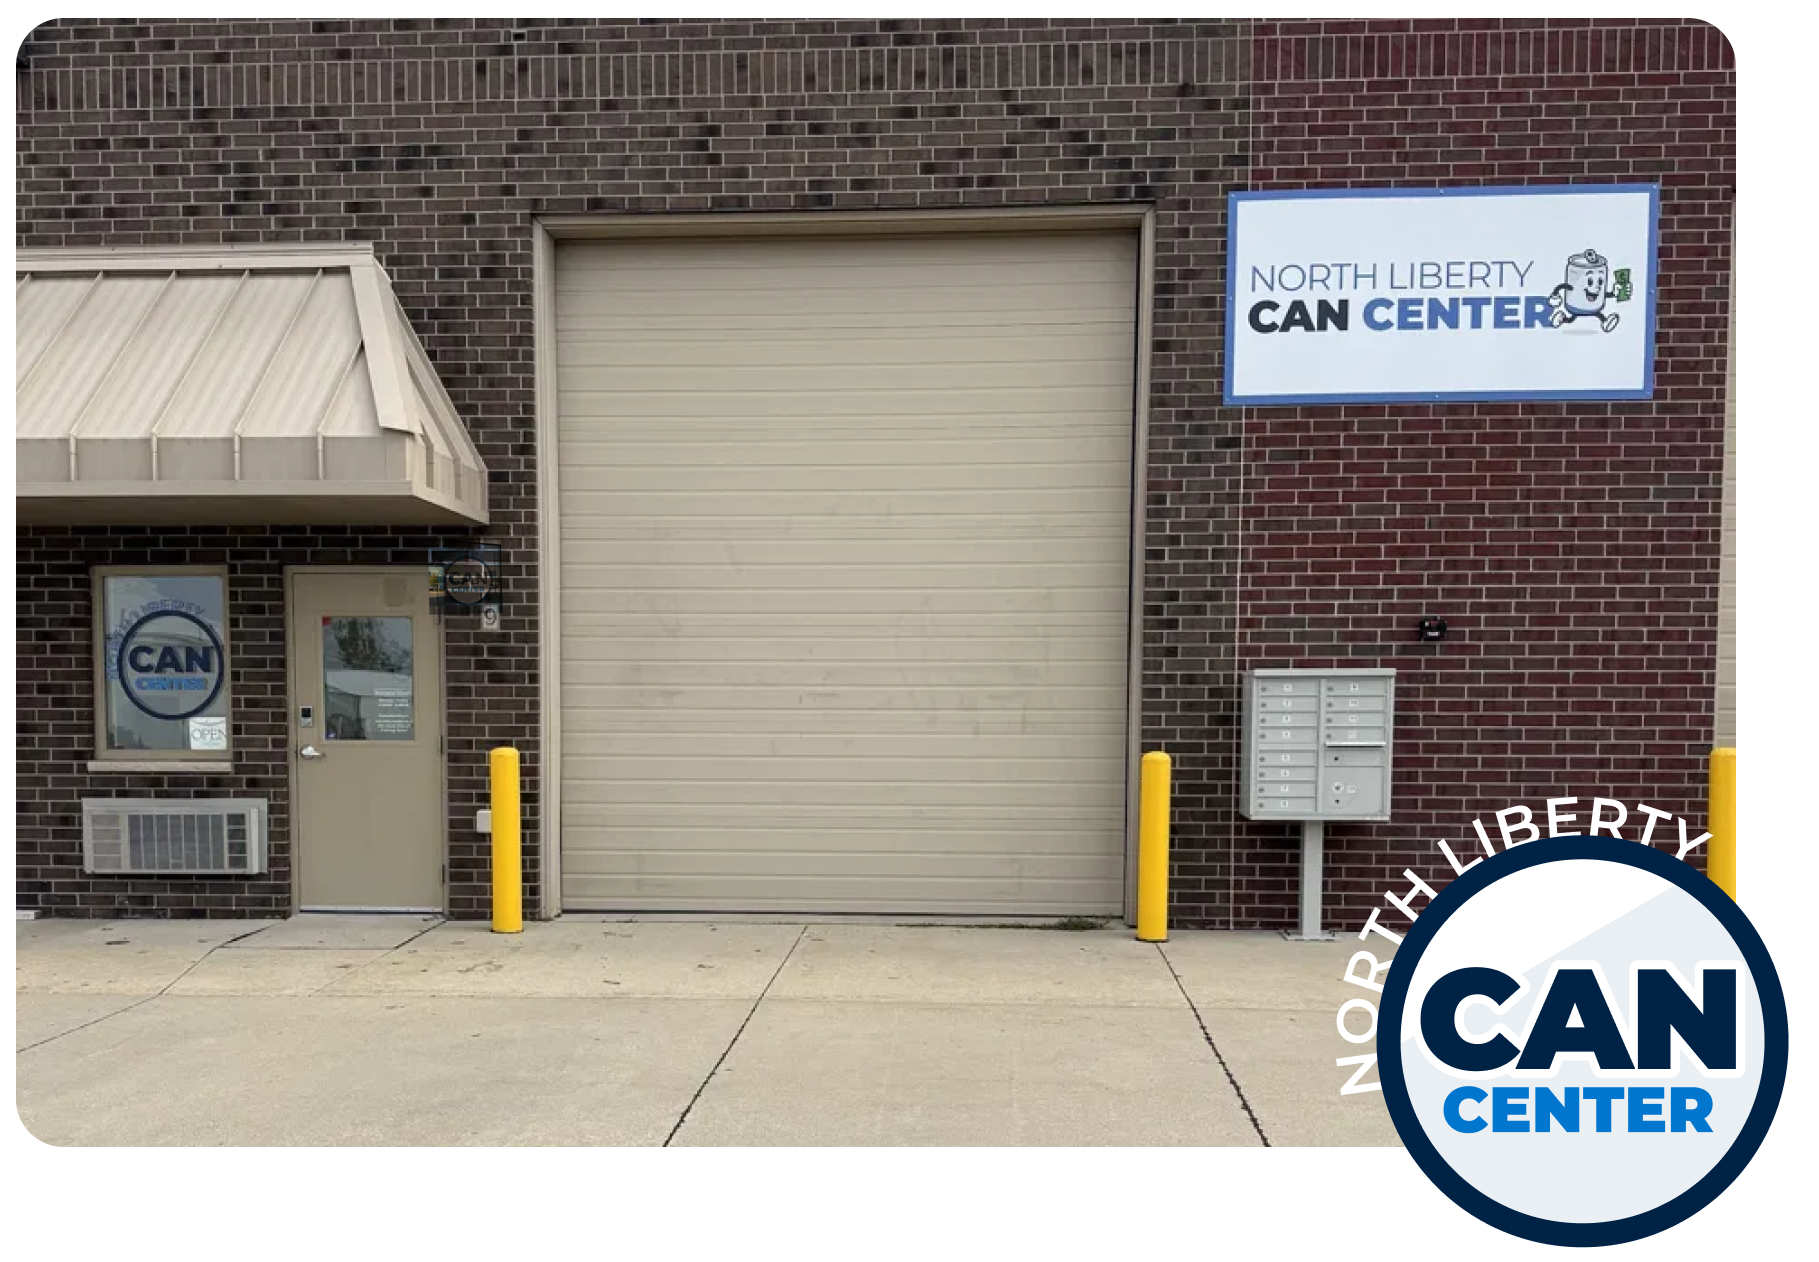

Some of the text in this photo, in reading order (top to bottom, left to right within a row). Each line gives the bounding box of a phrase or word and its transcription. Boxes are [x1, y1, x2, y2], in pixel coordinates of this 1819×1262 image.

[1252, 261, 1535, 292] NORTH LIBERTY
[1248, 296, 1552, 333] CAN CENTER
[449, 572, 488, 585] CAN
[484, 608, 497, 626] 9
[129, 646, 212, 673] CAN
[191, 728, 226, 741] OPEN
